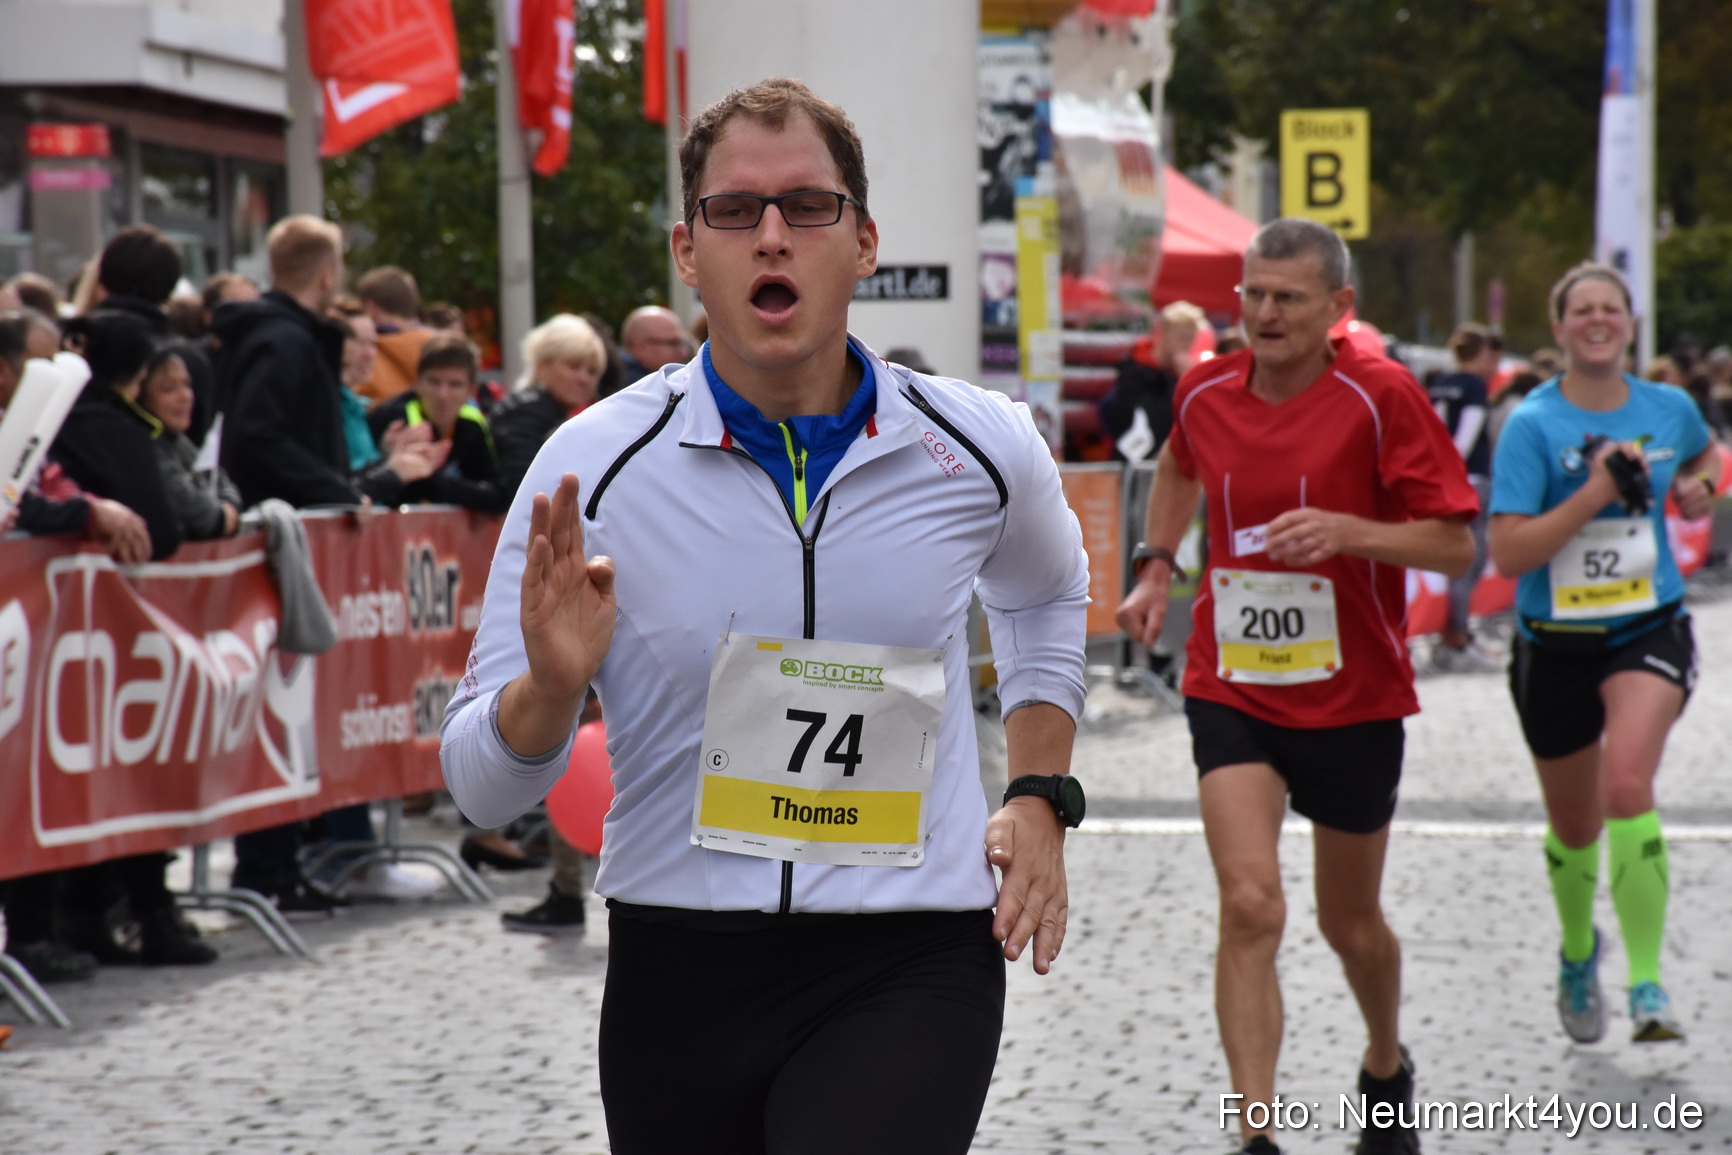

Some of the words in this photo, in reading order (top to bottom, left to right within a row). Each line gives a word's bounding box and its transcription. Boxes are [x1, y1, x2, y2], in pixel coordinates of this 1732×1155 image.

[1306, 152, 1344, 208] B
[854, 268, 942, 298] artl.de
[920, 439, 939, 464] UNNING
[924, 431, 965, 475] GORE
[1583, 550, 1622, 579] 52
[1240, 606, 1305, 641] 200
[802, 680, 828, 688] inspired
[828, 682, 838, 690] by
[804, 660, 884, 686] BOCK
[786, 708, 864, 777] 74
[713, 754, 722, 767] C
[771, 796, 858, 825] Thomas
